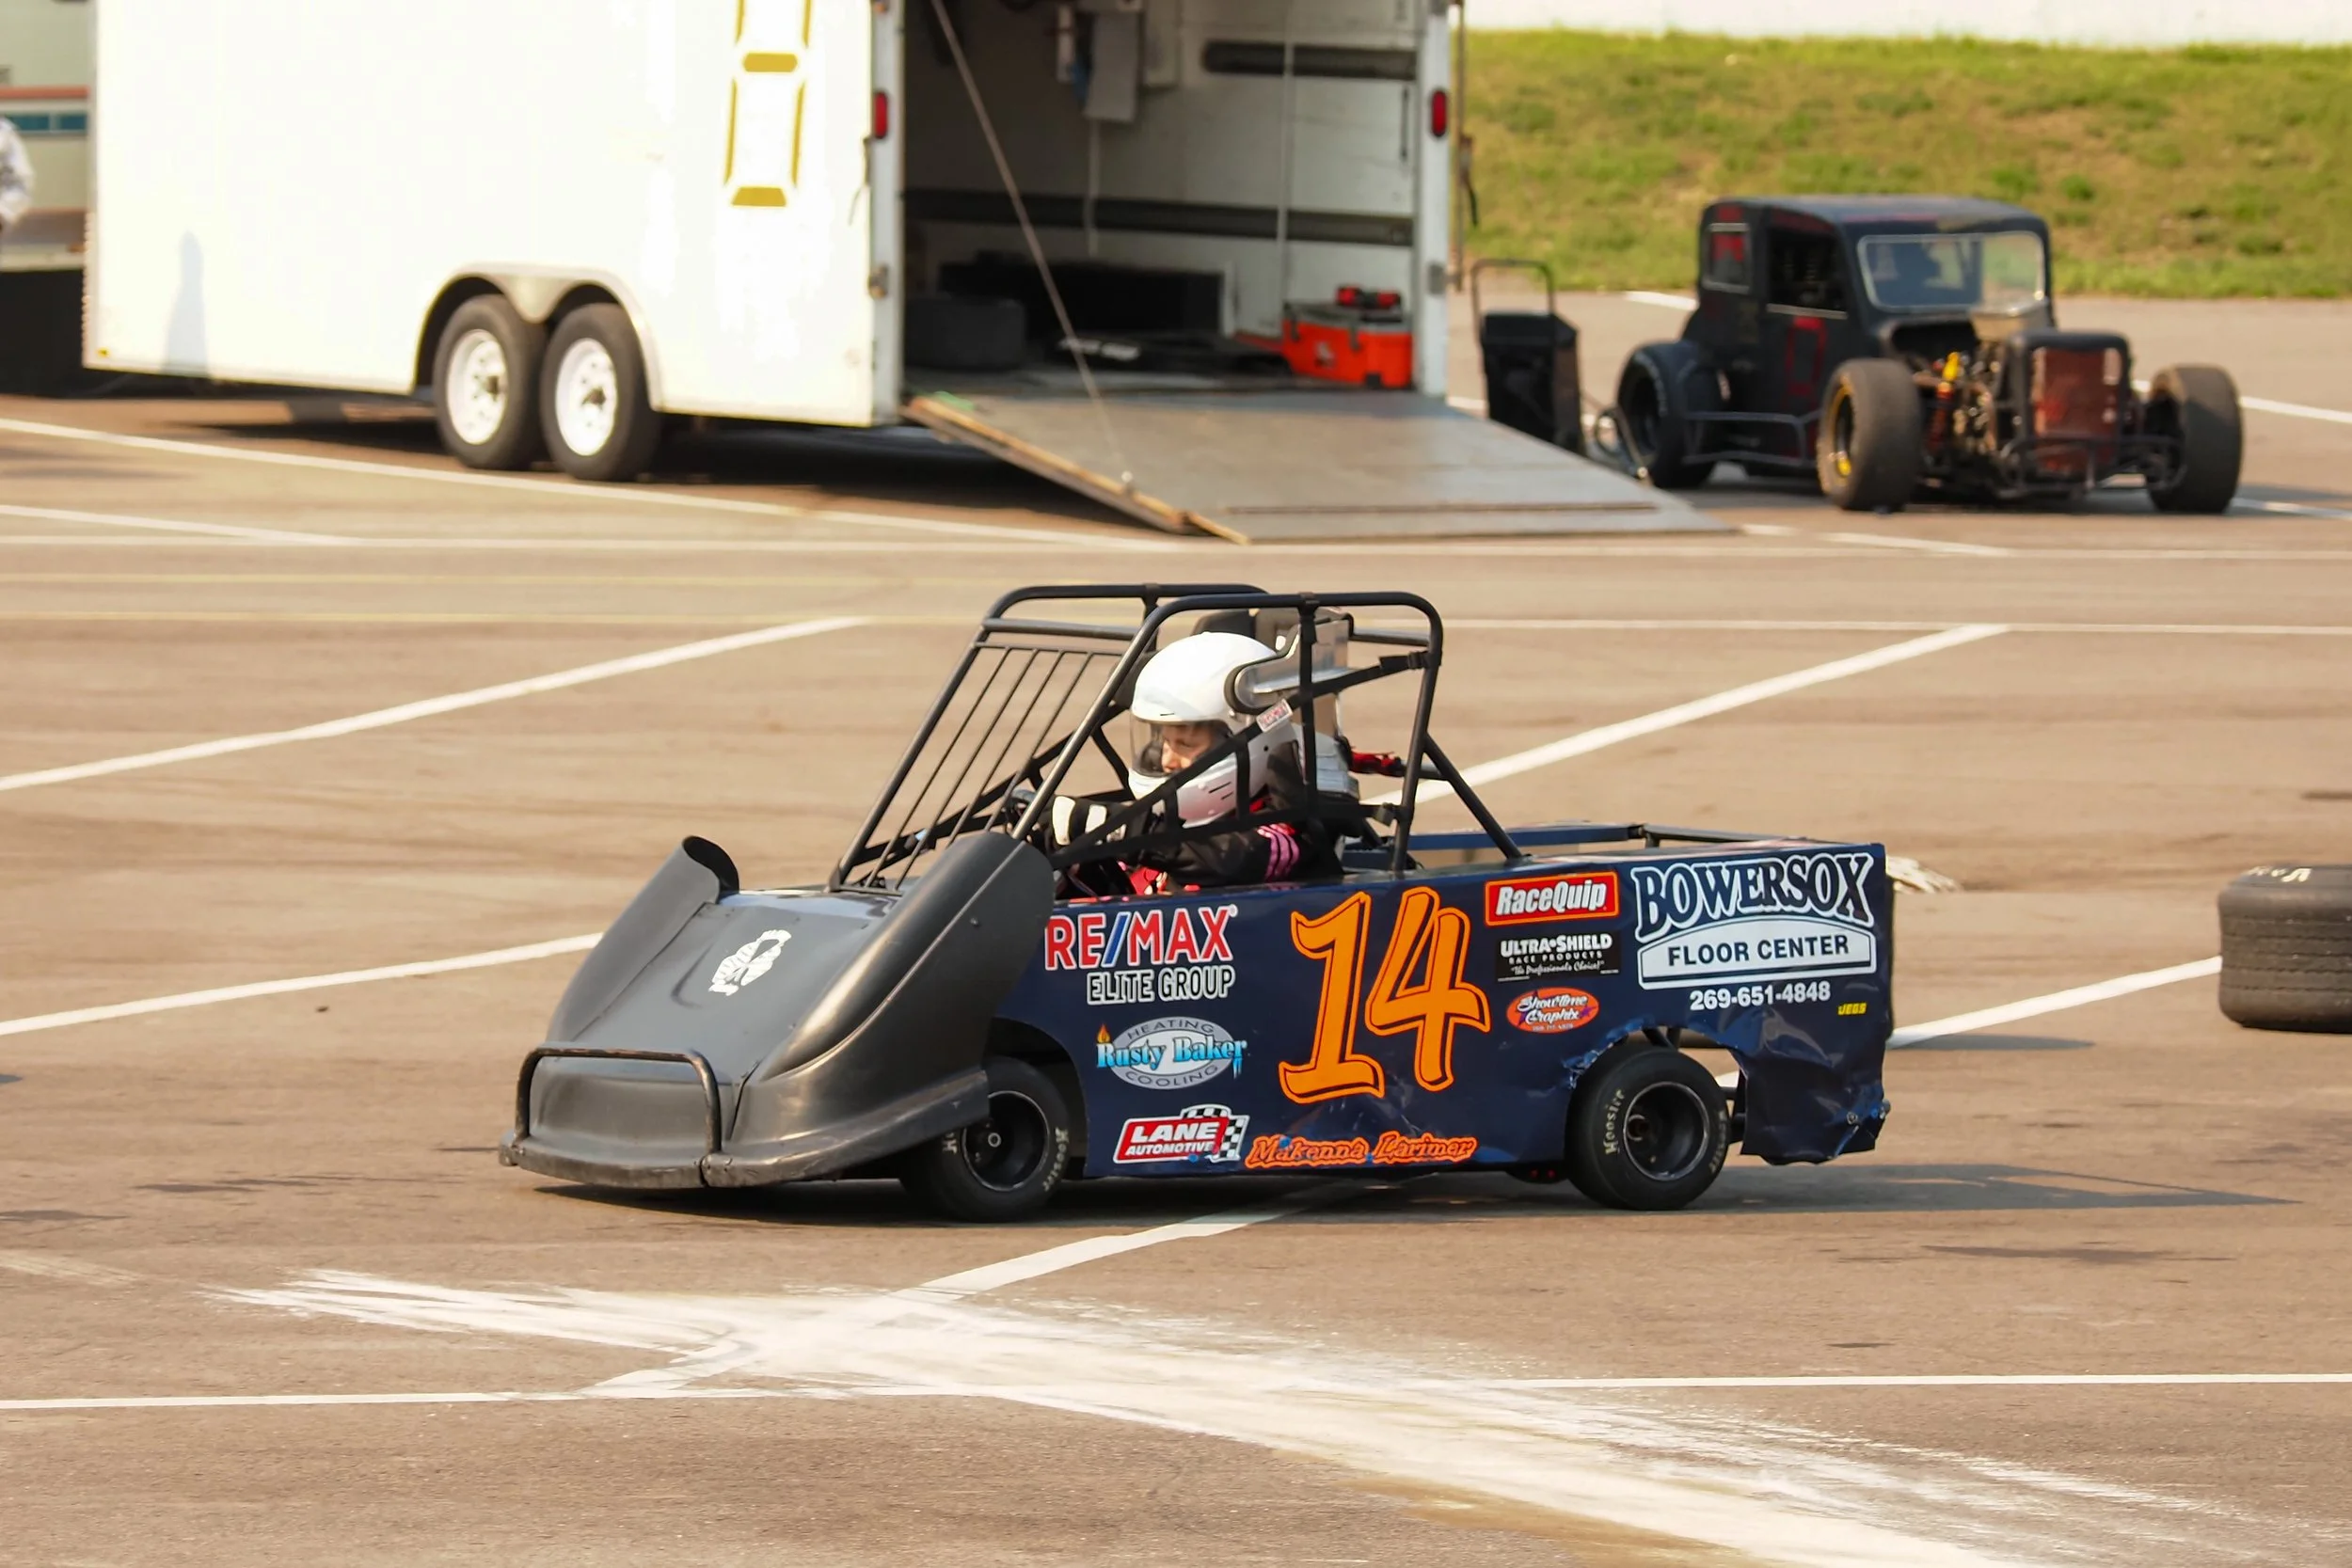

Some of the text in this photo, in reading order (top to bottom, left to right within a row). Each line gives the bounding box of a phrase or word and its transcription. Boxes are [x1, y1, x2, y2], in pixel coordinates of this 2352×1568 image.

[1496, 879, 1607, 915] RaceQuip
[1630, 852, 1874, 942] BOWERSOX
[1045, 907, 1234, 971] RE/MAX
[1668, 935, 1850, 967] FLOOR CENTER
[1509, 951, 1603, 965] RACE PRODUCTS
[1087, 965, 1235, 1005] ELITE GROUP
[1279, 887, 1491, 1103] 14
[1690, 981, 1831, 1011] 269-651-4848
[1127, 1019, 1216, 1039] HEATING
[1097, 1036, 1248, 1070] Rusty Baker
[1125, 1065, 1218, 1087] COOLING
[1125, 1141, 1216, 1156] AUTOMOTIVE
[1131, 1121, 1220, 1143] LANE
[1373, 1130, 1478, 1164] Larimer
